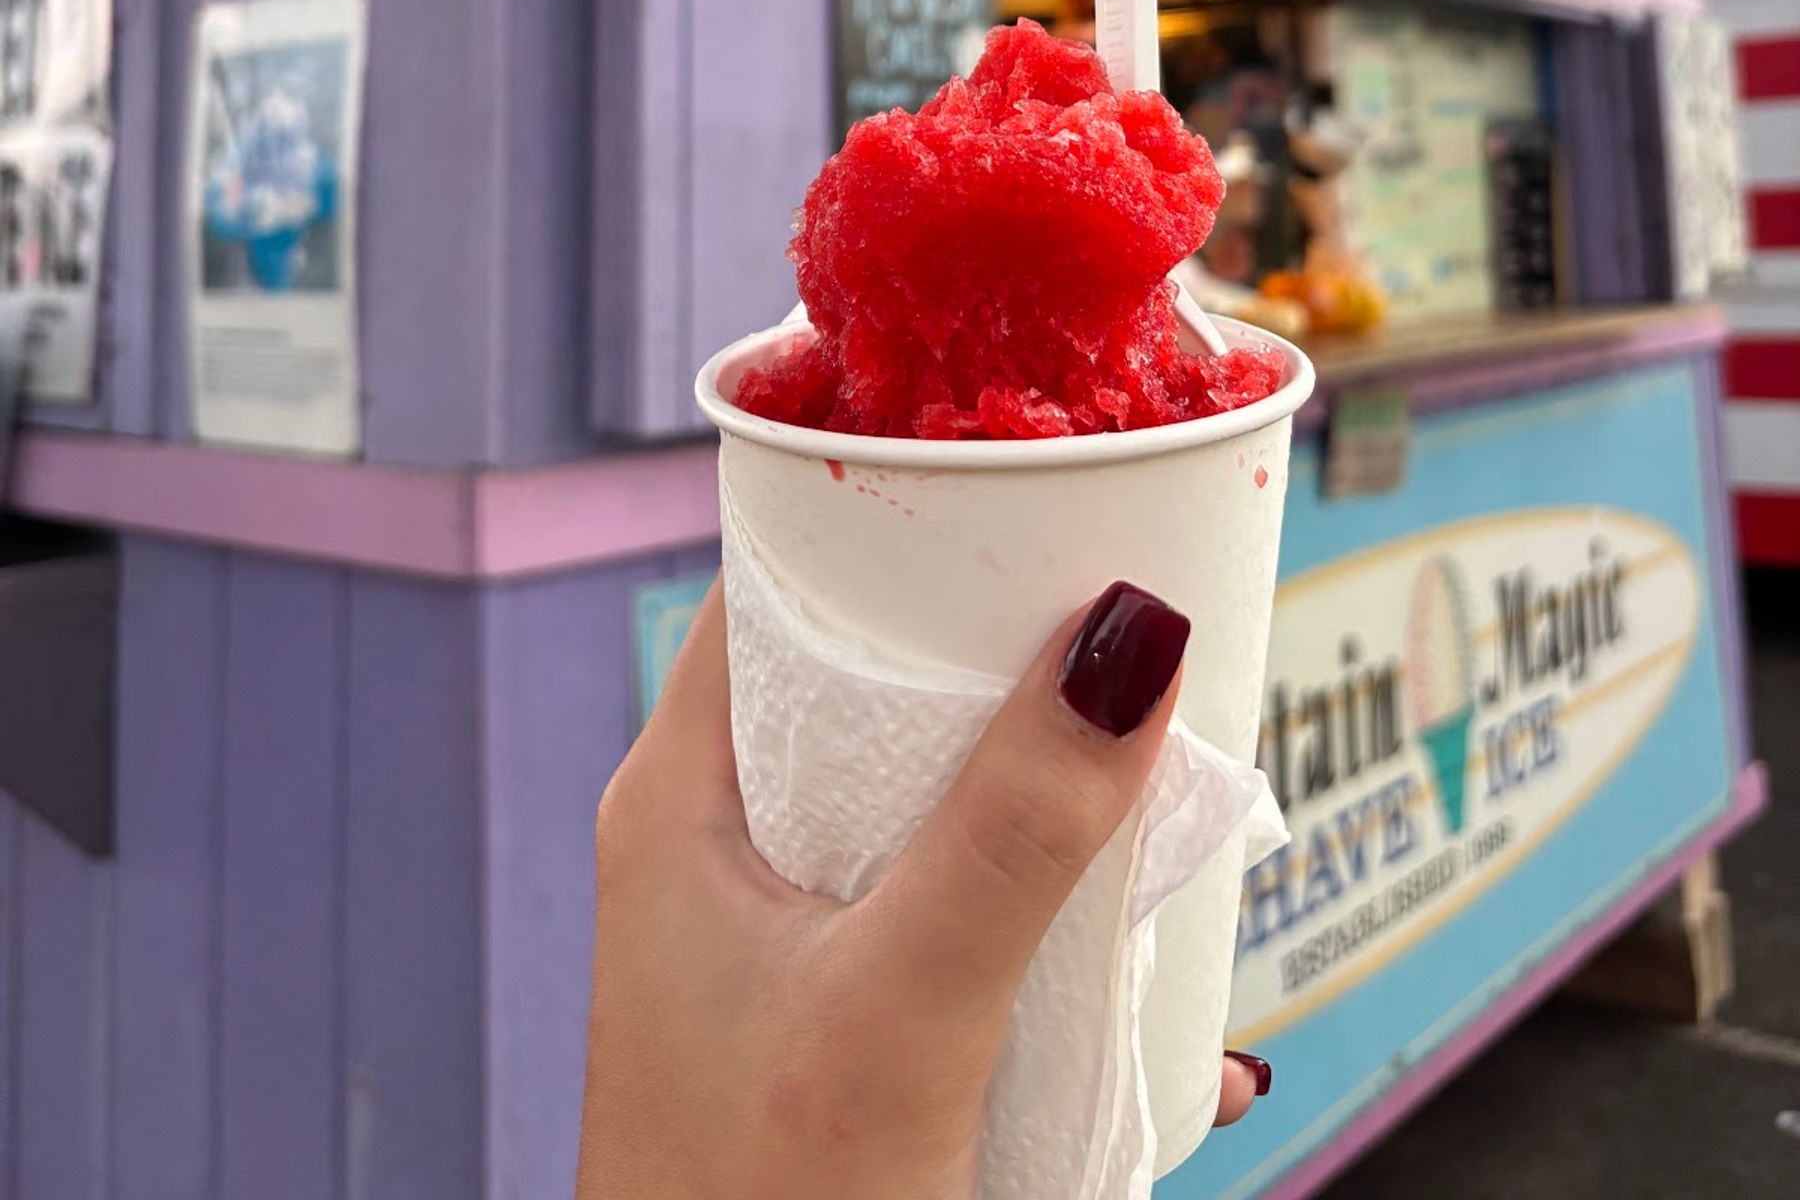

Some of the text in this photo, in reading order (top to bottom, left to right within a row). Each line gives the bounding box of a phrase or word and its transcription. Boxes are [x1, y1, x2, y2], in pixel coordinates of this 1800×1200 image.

[1258, 538, 1625, 813] tain Magic
[1236, 694, 1562, 956] HAVE ICE
